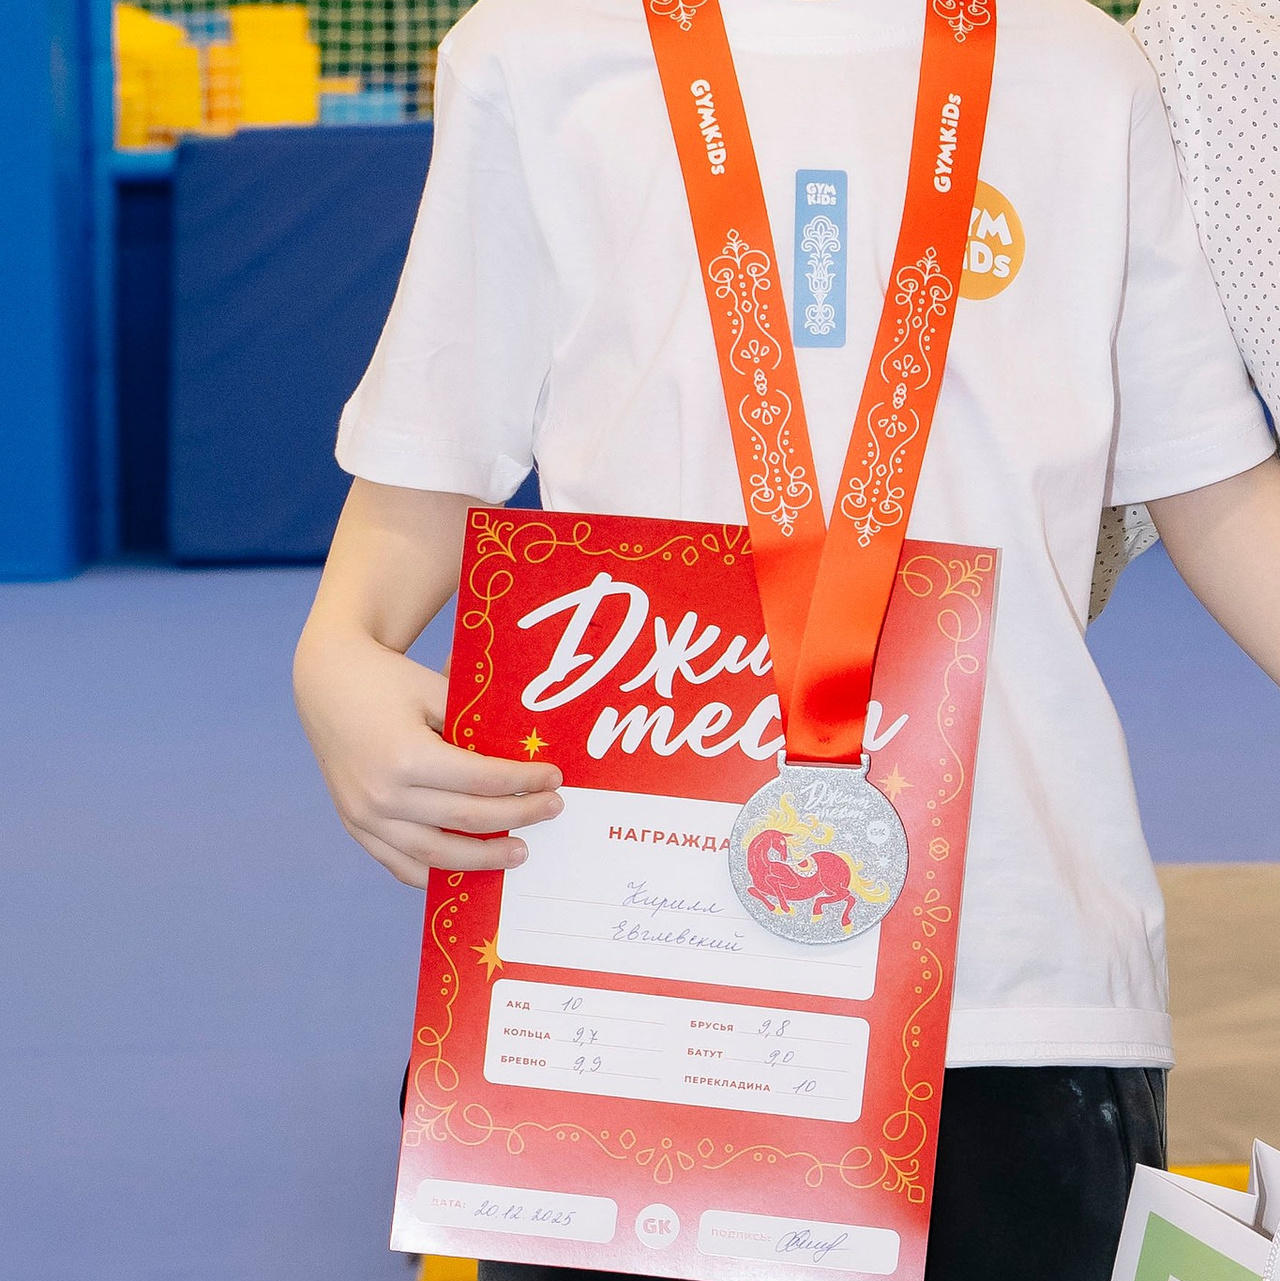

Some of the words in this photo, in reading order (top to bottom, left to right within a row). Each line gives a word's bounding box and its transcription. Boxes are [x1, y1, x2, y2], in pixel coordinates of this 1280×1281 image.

[806, 182, 837, 195] GYM
[518, 572, 774, 712] Джи
[586, 693, 910, 760] тес
[608, 826, 730, 852] НАГРАЖДА
[622, 880, 727, 918] Кирилл
[506, 1000, 531, 1011] АКД
[561, 997, 583, 1011] 10
[503, 1027, 551, 1040] КОЛЬЦА
[690, 1020, 734, 1032] БРУСЬЯ
[758, 1019, 791, 1038] 9,8
[500, 1055, 547, 1067] БРЕВНО
[687, 1048, 723, 1059] БАТУТ
[573, 1056, 602, 1075] 9,9
[684, 1075, 771, 1092] ПЕРЕКЛАДИНА
[792, 1079, 817, 1094] 10
[430, 1196, 466, 1209] ДАТА:
[642, 1218, 672, 1235] GK
[710, 1226, 772, 1243] ПОДПИСЬ:
